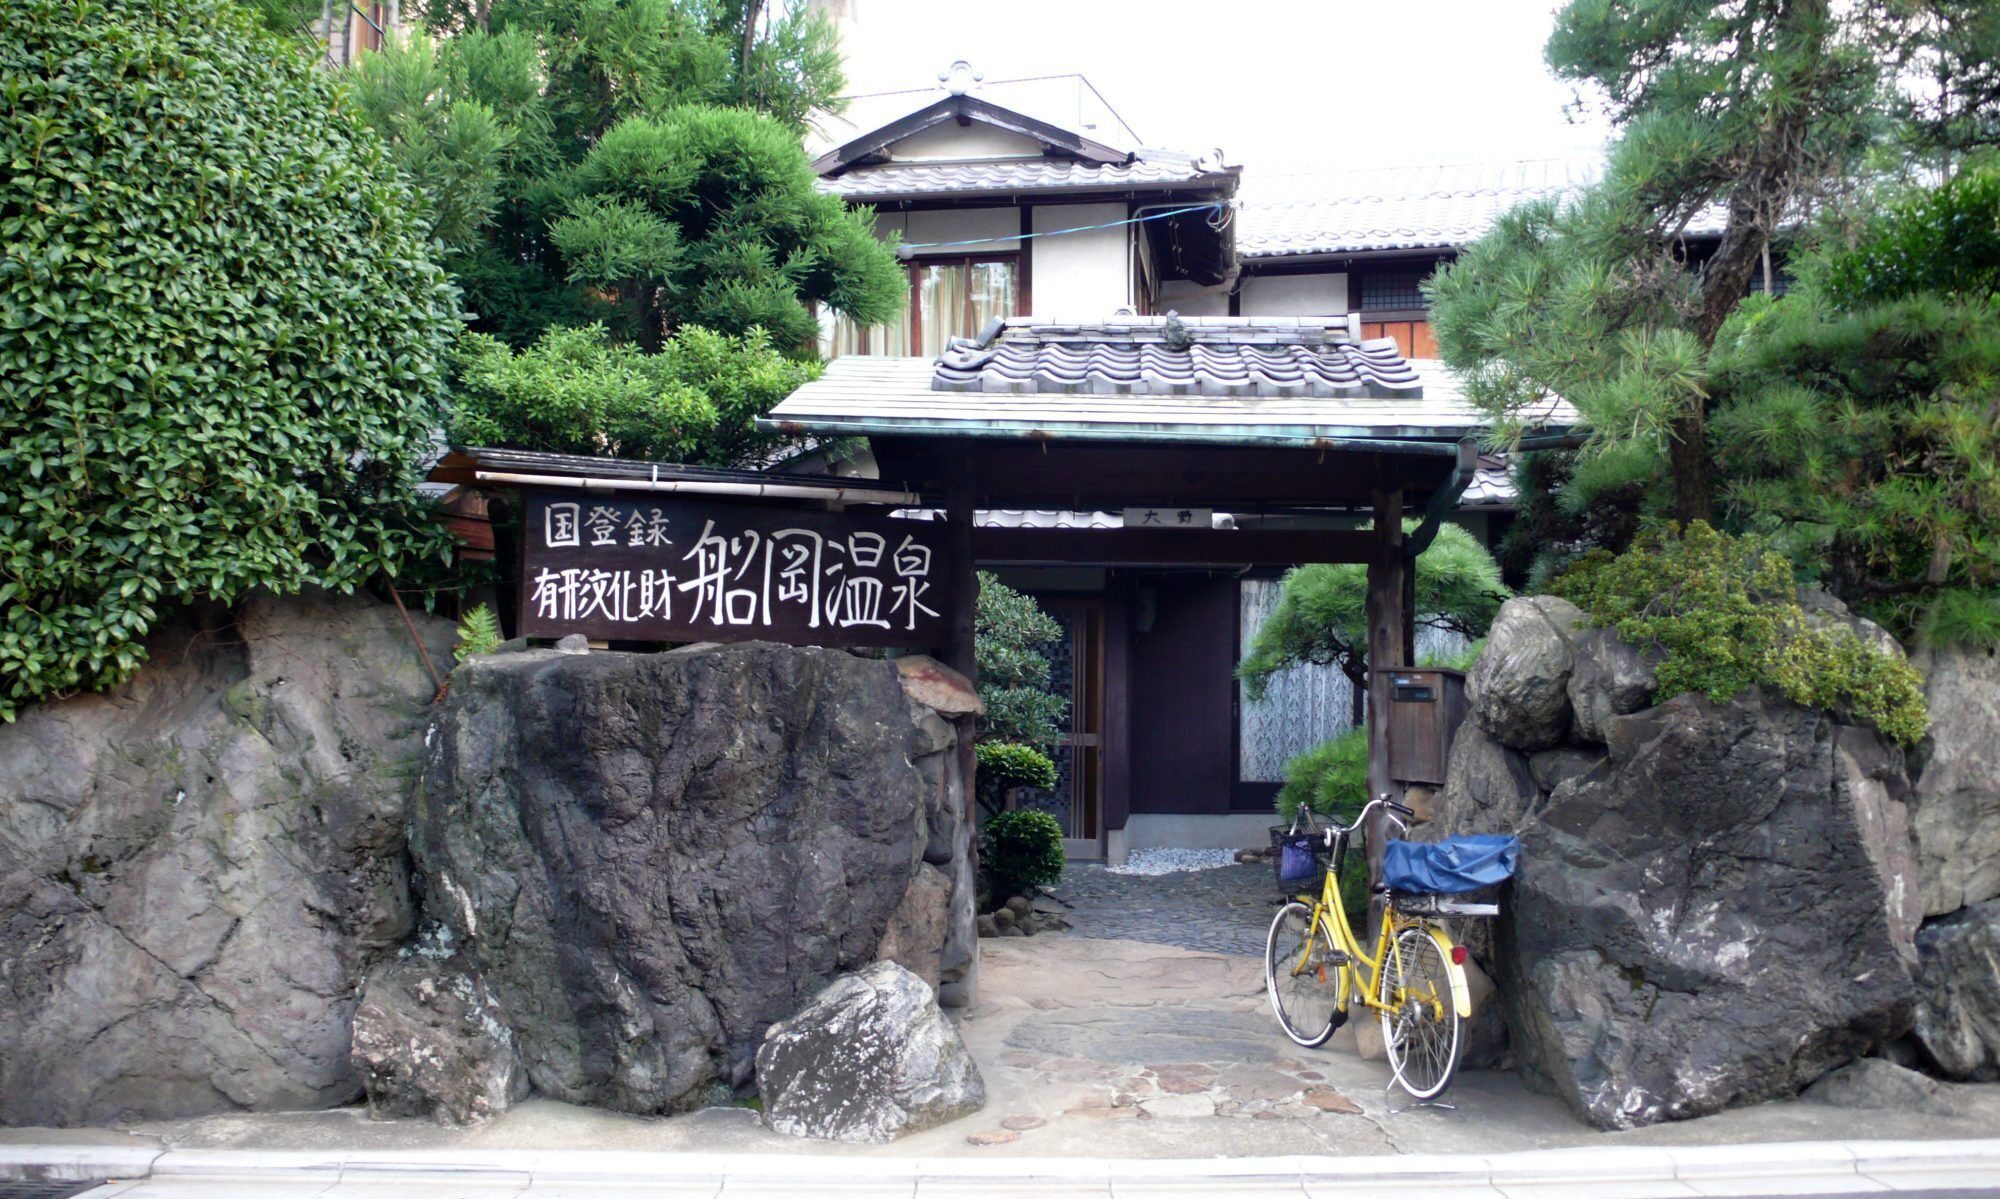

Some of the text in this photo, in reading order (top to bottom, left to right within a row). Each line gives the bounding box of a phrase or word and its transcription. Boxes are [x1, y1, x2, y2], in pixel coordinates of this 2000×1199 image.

[545, 502, 673, 548] 国登録
[1142, 509, 1193, 525] 大野
[531, 567, 677, 622] 有形文化財
[677, 519, 940, 631] 船岡温泉
